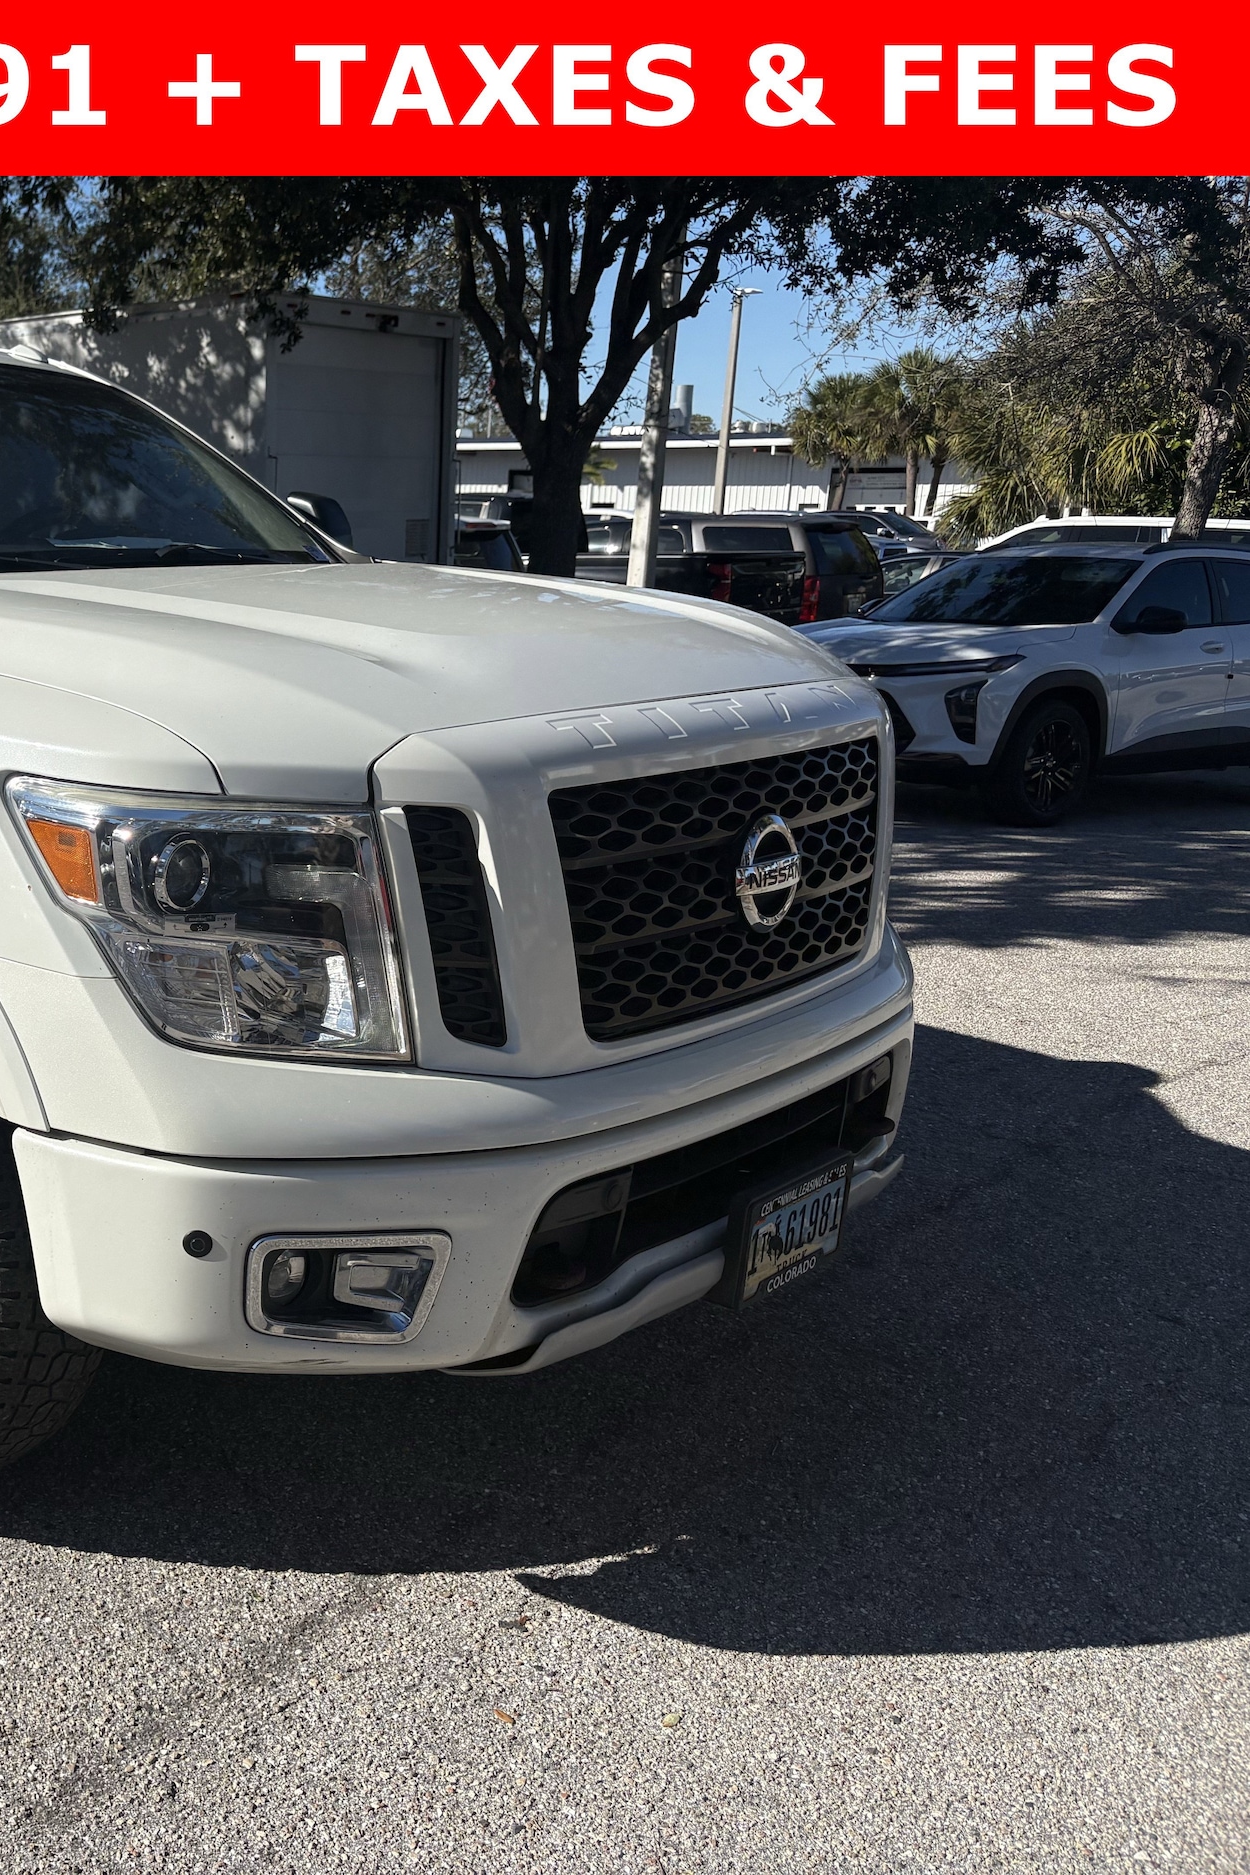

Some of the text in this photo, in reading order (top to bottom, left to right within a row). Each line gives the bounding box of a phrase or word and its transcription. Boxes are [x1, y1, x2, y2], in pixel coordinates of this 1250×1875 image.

[545, 684, 860, 750] TITAN
[749, 860, 800, 890] NISSAN
[829, 1163, 848, 1182] SES
[783, 1186, 842, 1256] 61981
[767, 1256, 817, 1293] COLORADO
